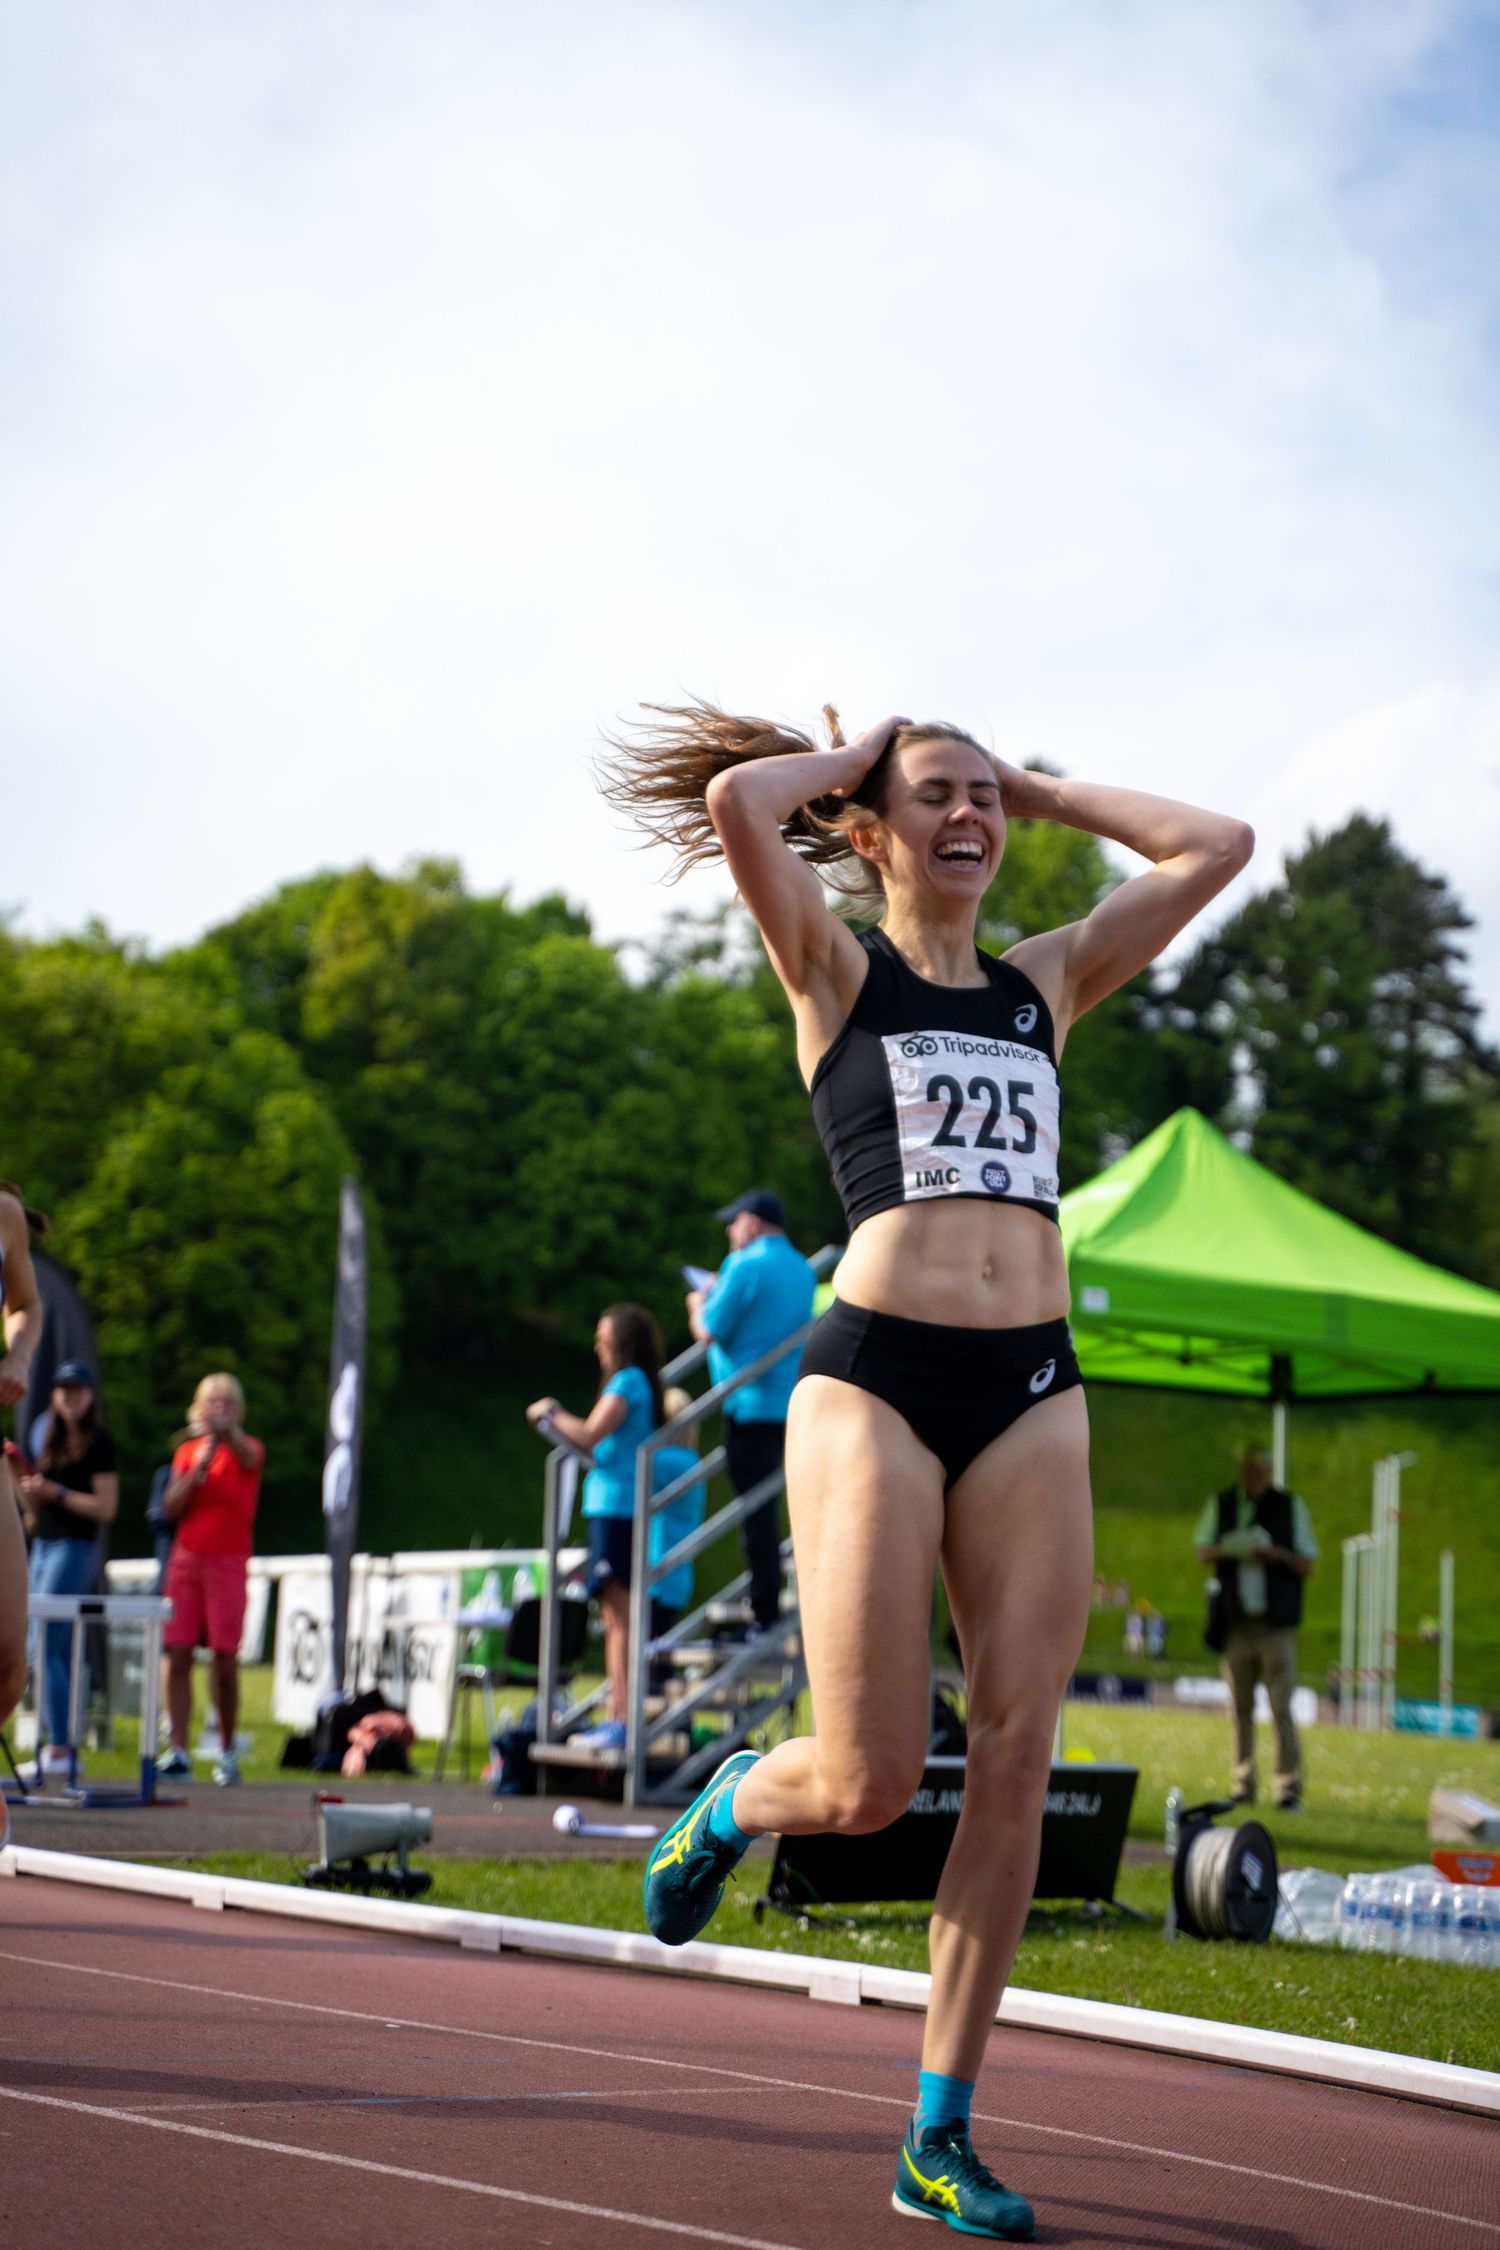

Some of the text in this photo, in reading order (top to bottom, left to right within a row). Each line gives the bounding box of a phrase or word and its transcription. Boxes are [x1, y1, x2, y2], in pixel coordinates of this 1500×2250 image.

[939, 1036, 1040, 1063] Tripadvisor
[926, 1074, 1038, 1154] 225
[916, 1167, 961, 1188] IMC
